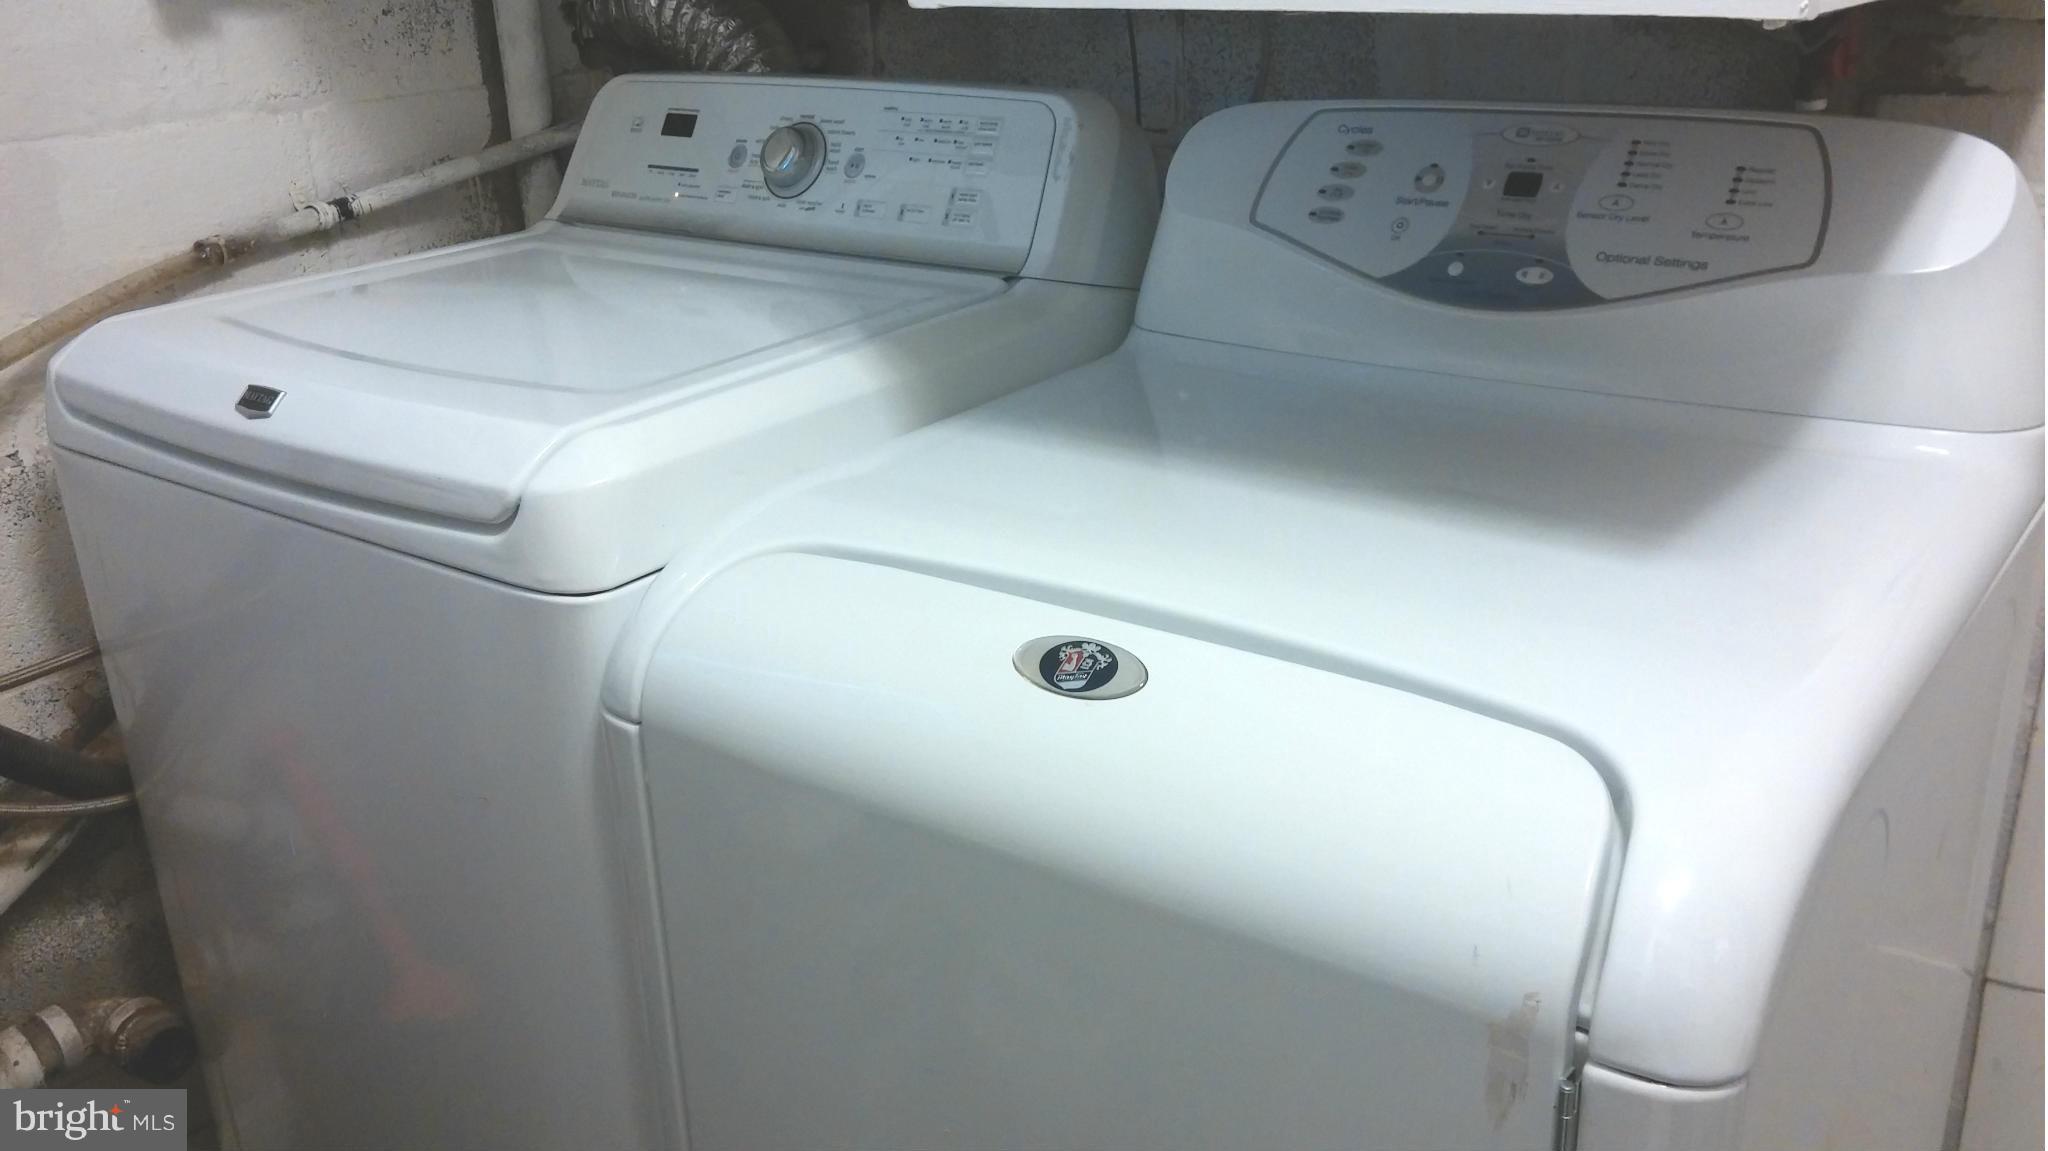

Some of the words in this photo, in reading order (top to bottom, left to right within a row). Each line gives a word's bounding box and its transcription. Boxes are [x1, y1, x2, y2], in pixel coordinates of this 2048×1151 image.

[1337, 123, 1374, 136] Cycles
[1595, 250, 1652, 266] Optional
[1653, 254, 1709, 271] Settings
